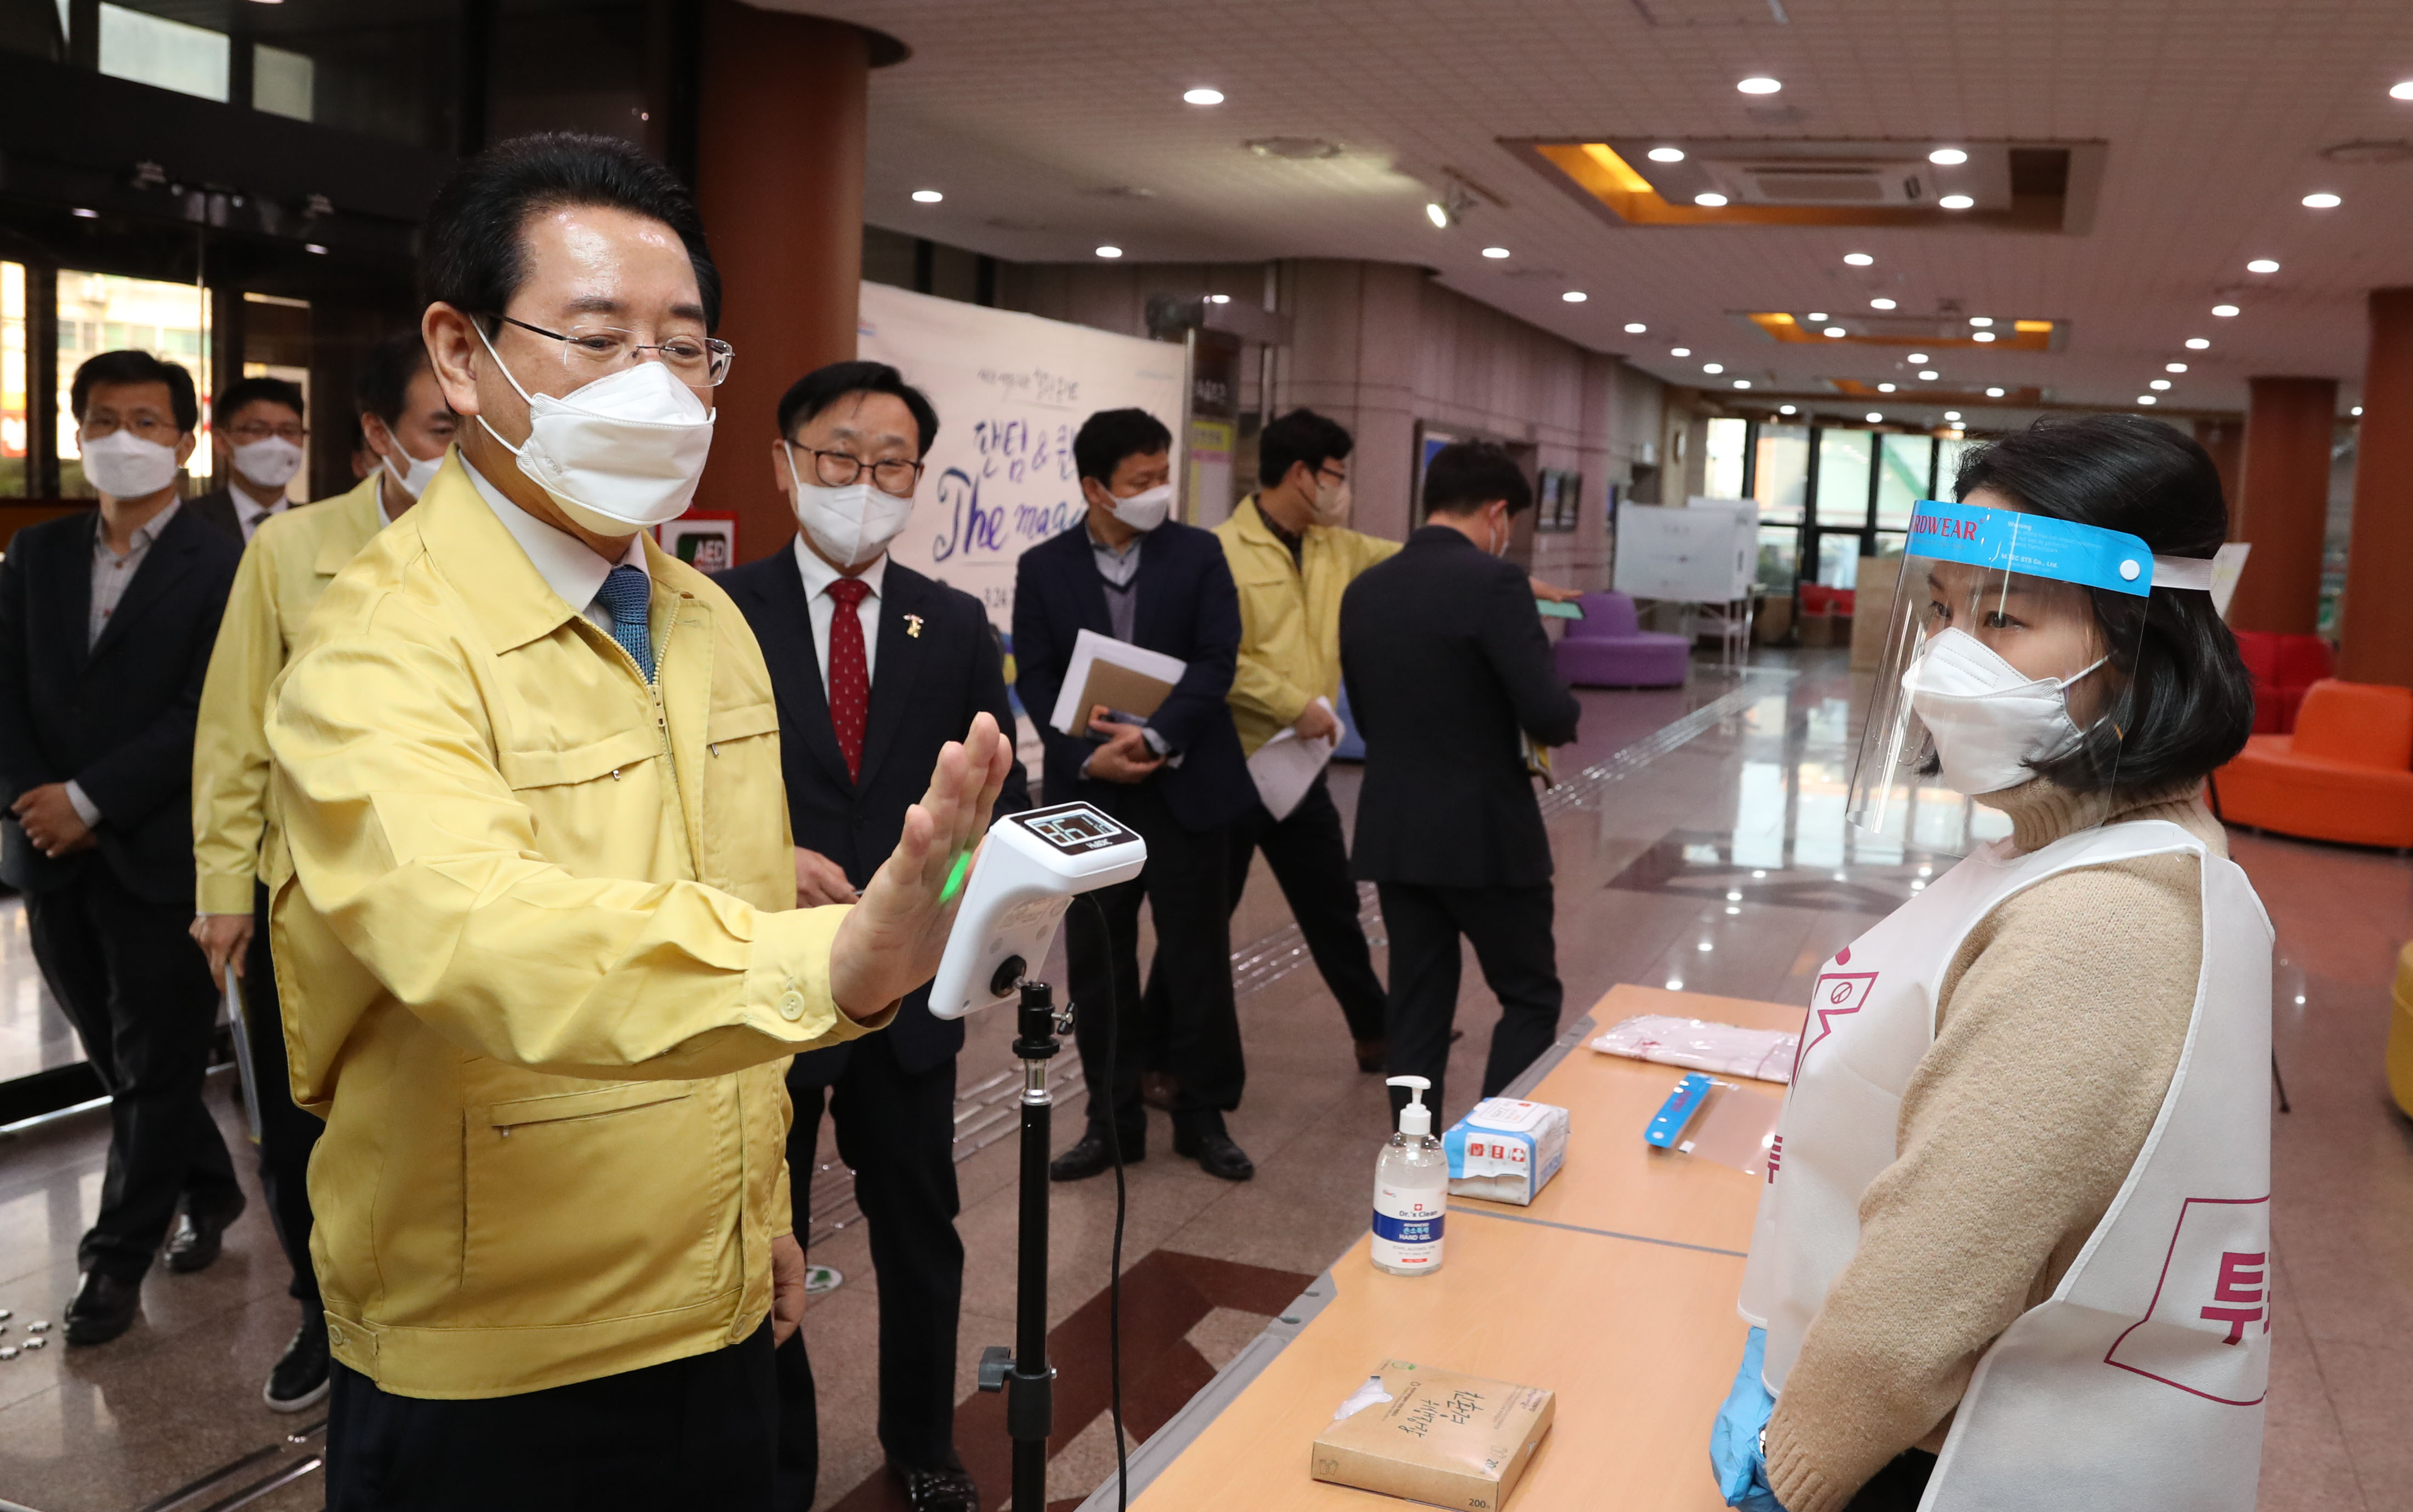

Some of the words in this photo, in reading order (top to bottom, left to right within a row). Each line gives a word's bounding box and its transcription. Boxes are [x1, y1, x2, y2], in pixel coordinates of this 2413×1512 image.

[933, 467, 1009, 562] The
[2008, 521, 2032, 531] Waning
[694, 540, 725, 563] AED
[2200, 1251, 2271, 1345] 투
[1398, 1399, 1440, 1438] 위생장갑
[1439, 1390, 1485, 1424] 친환경
[1468, 1498, 1486, 1508] 200
